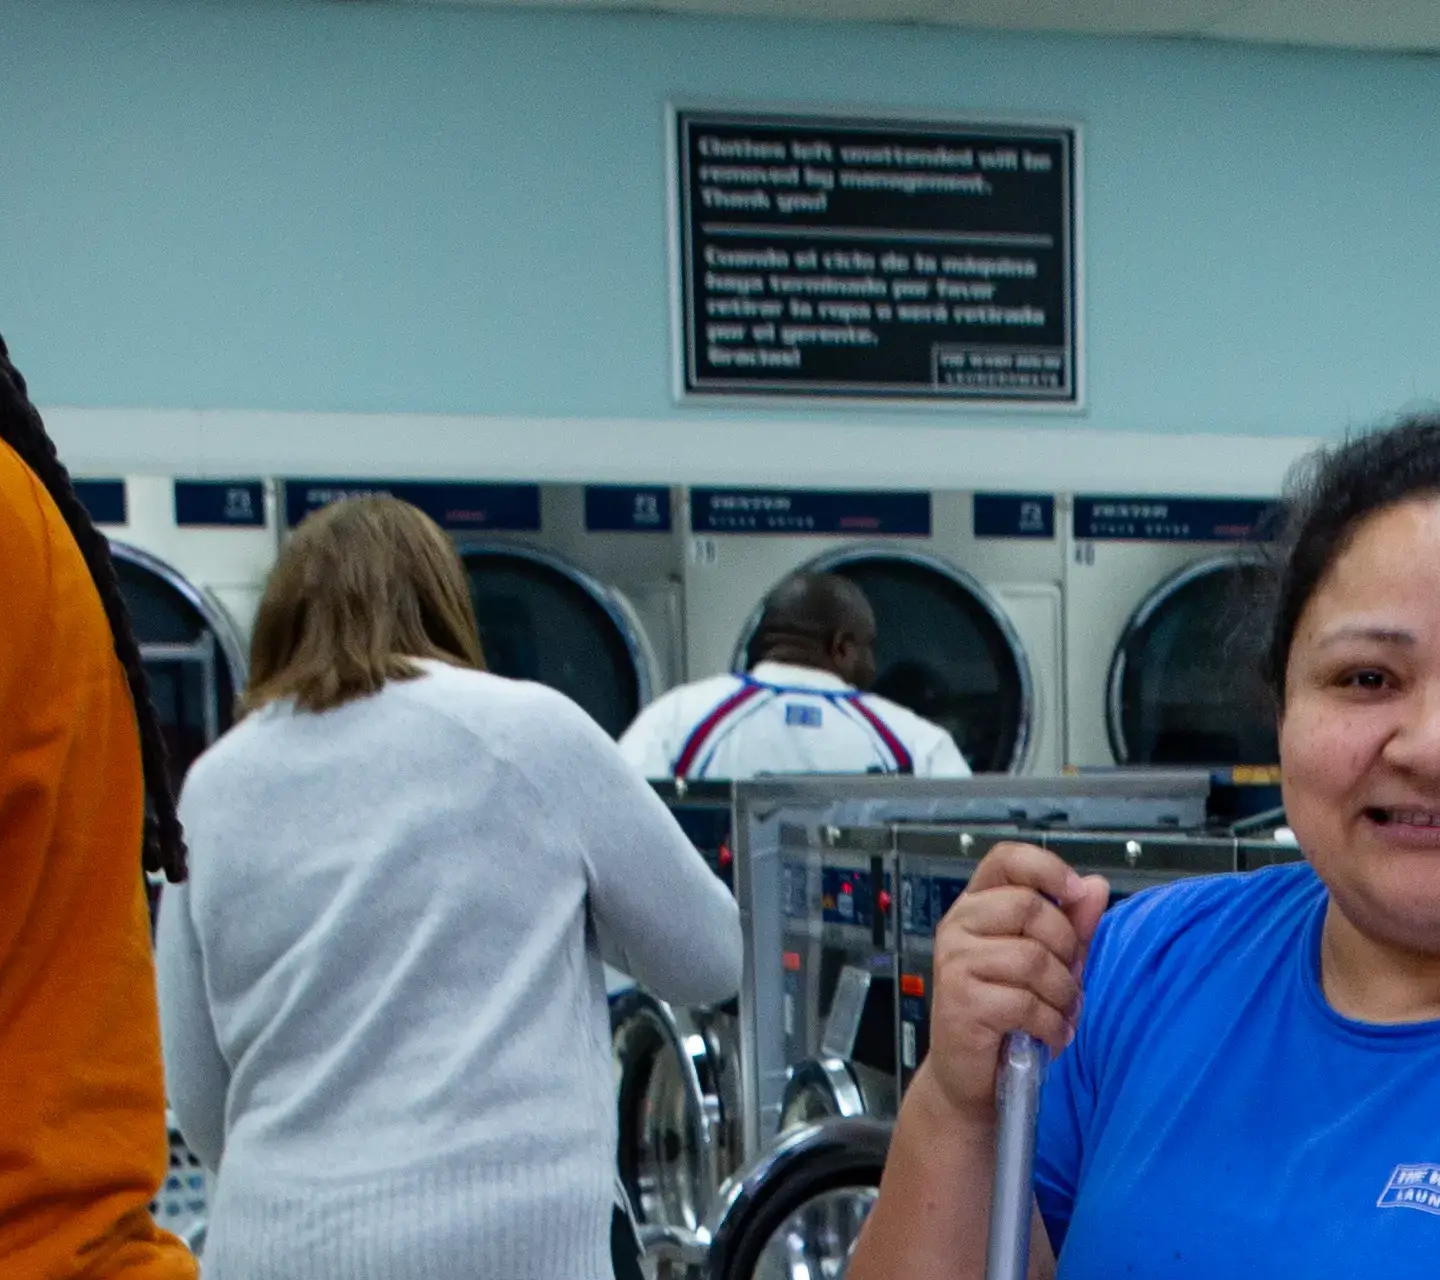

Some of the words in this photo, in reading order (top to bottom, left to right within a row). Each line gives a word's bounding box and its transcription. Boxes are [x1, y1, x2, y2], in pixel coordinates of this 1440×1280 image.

[698, 136, 786, 160] Clothes
[791, 139, 834, 162] left
[839, 144, 974, 169] unattended
[978, 147, 1018, 170] will
[1022, 149, 1052, 171] be
[699, 166, 800, 187] removed
[804, 166, 835, 191] by
[701, 186, 771, 211] Thank
[705, 245, 790, 270] Cuando
[794, 248, 818, 271] el
[822, 249, 875, 271] ciclo
[880, 250, 909, 273] de
[914, 252, 937, 275] la
[705, 270, 764, 295] haya
[768, 273, 887, 298] terminado
[891, 277, 929, 301] por
[936, 276, 995, 300] favor
[706, 297, 783, 318] retirar
[789, 297, 813, 320] la
[818, 301, 872, 324] ropa
[706, 321, 747, 344] por
[752, 321, 776, 344] el
[1399, 1170, 1428, 1185] THE
